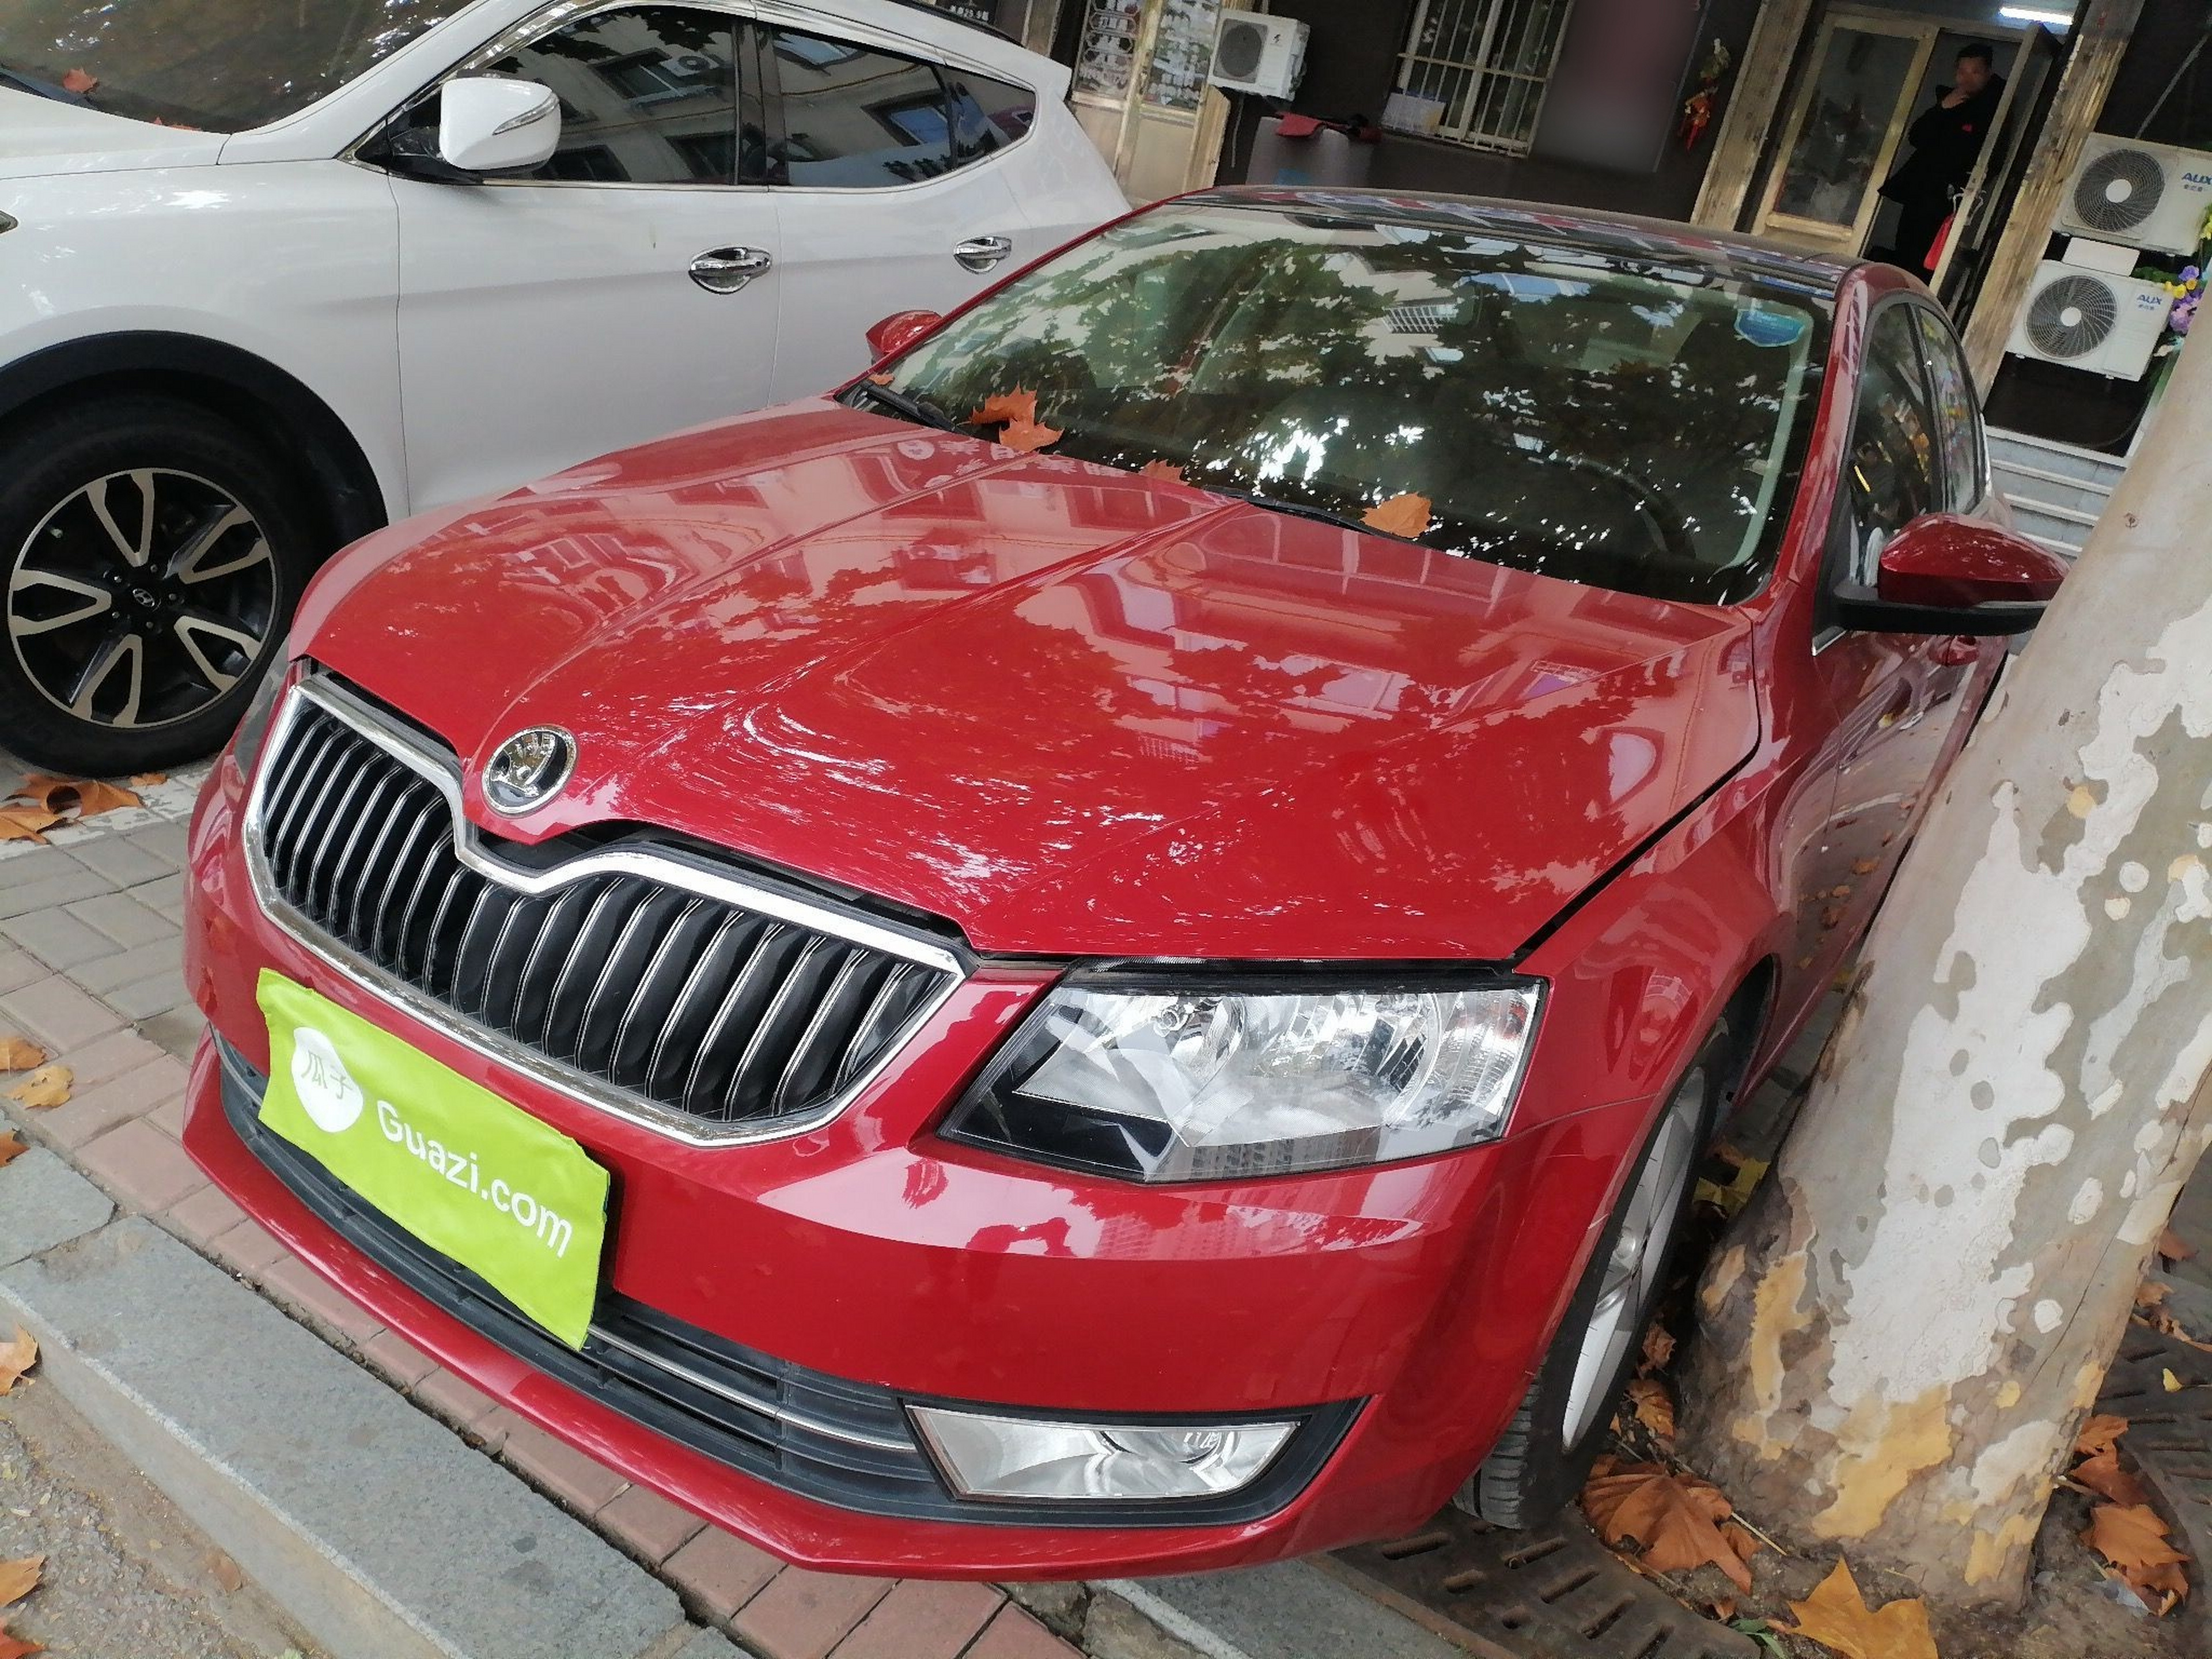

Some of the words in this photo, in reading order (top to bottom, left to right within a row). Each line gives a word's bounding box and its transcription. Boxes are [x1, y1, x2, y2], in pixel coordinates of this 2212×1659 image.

[2137, 294, 2162, 305] AUX
[301, 1050, 353, 1100] 瓜子
[377, 1101, 573, 1257] Guazi.com
